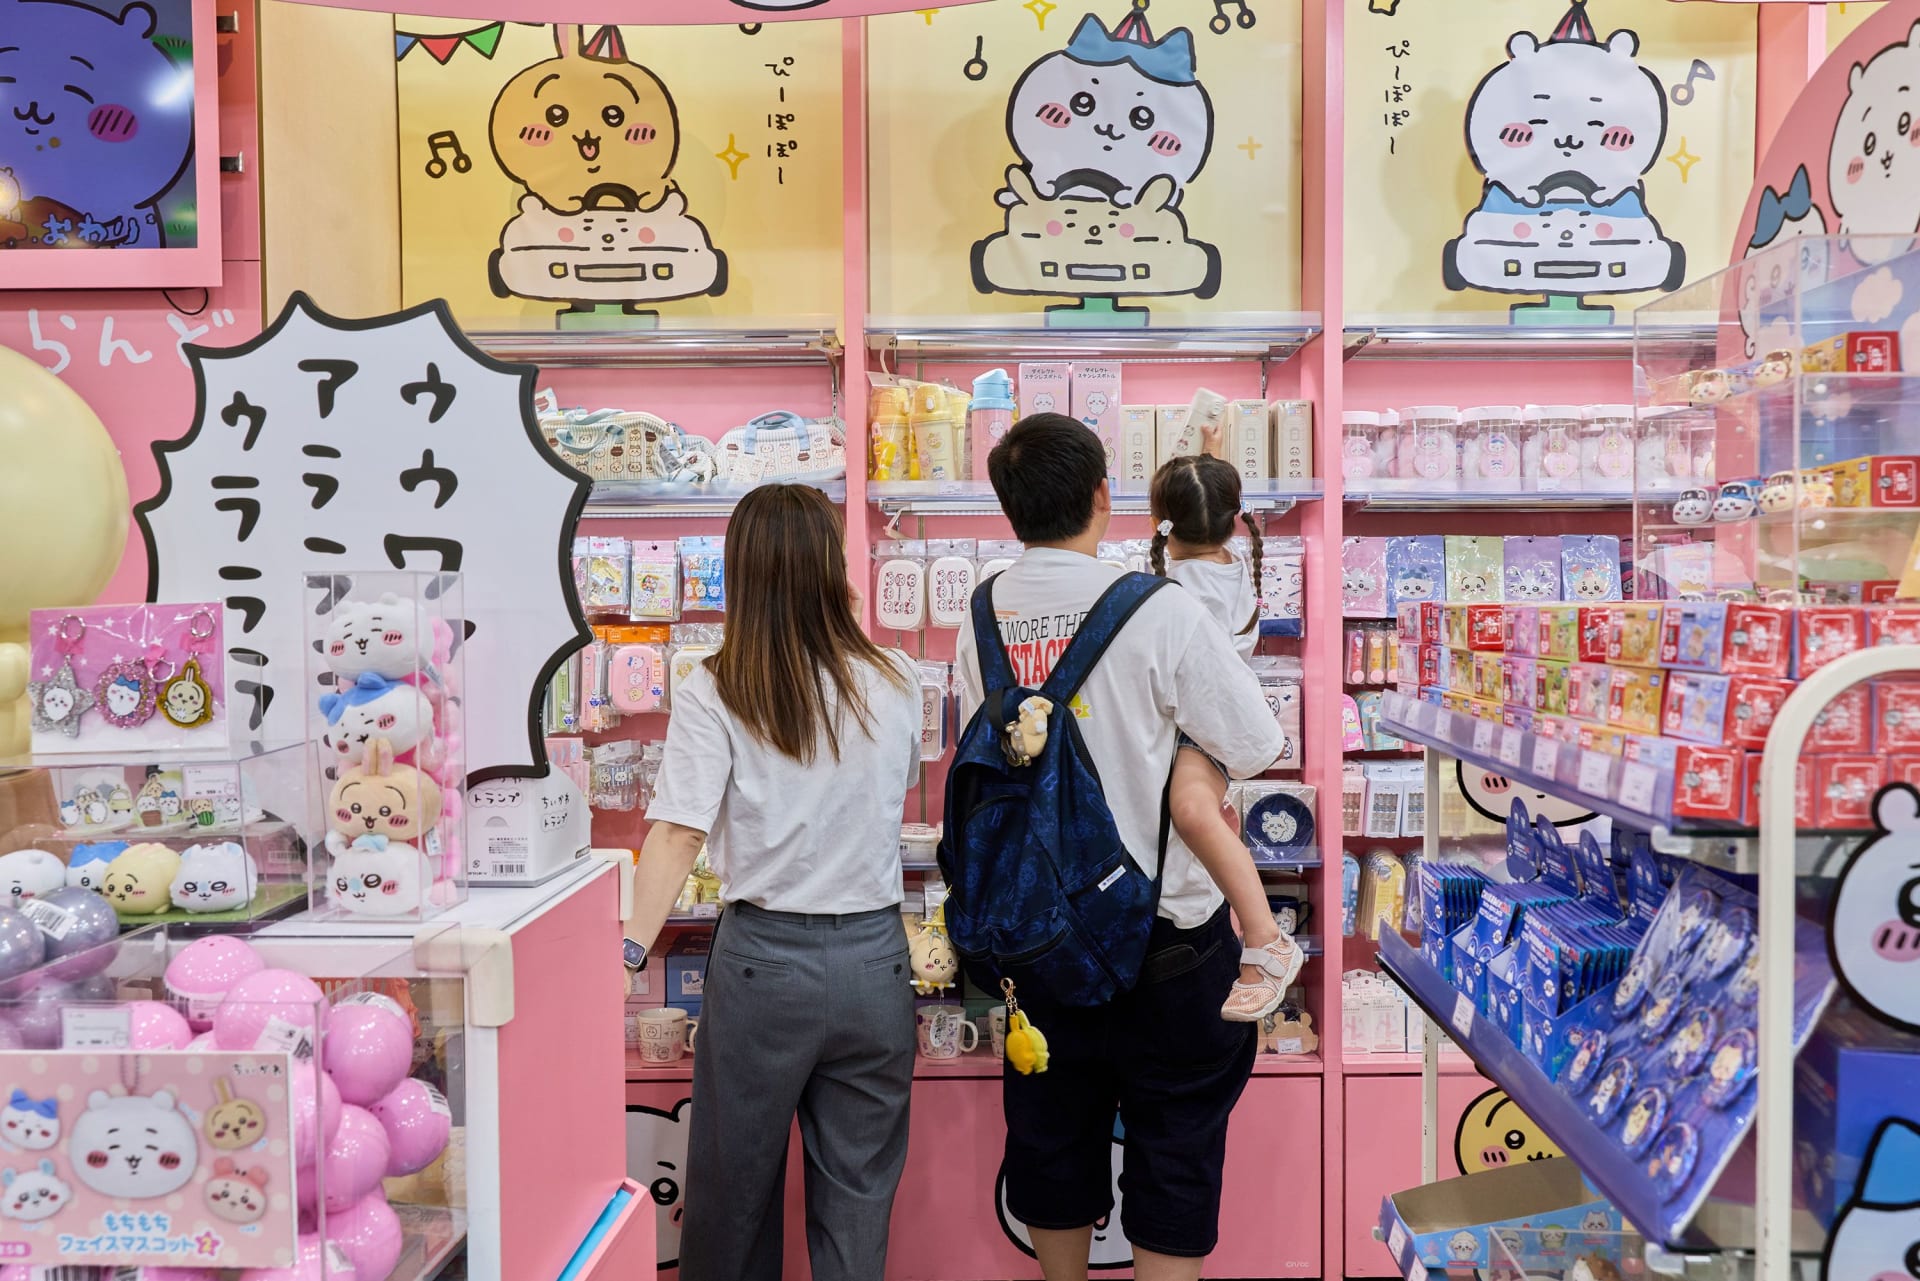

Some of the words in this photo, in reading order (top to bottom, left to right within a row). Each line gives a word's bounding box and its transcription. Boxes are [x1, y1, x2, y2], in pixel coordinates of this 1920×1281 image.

[42, 212, 141, 246] おわり
[28, 309, 235, 376] らんど
[1006, 615, 1050, 643] WORE
[1004, 638, 1073, 687] STAC
[473, 792, 521, 805] トランプ
[541, 792, 571, 809] ちいかわ
[544, 812, 569, 829] トランプ
[105, 1213, 169, 1232] もちもち
[59, 1235, 195, 1252] フェイスマスコット
